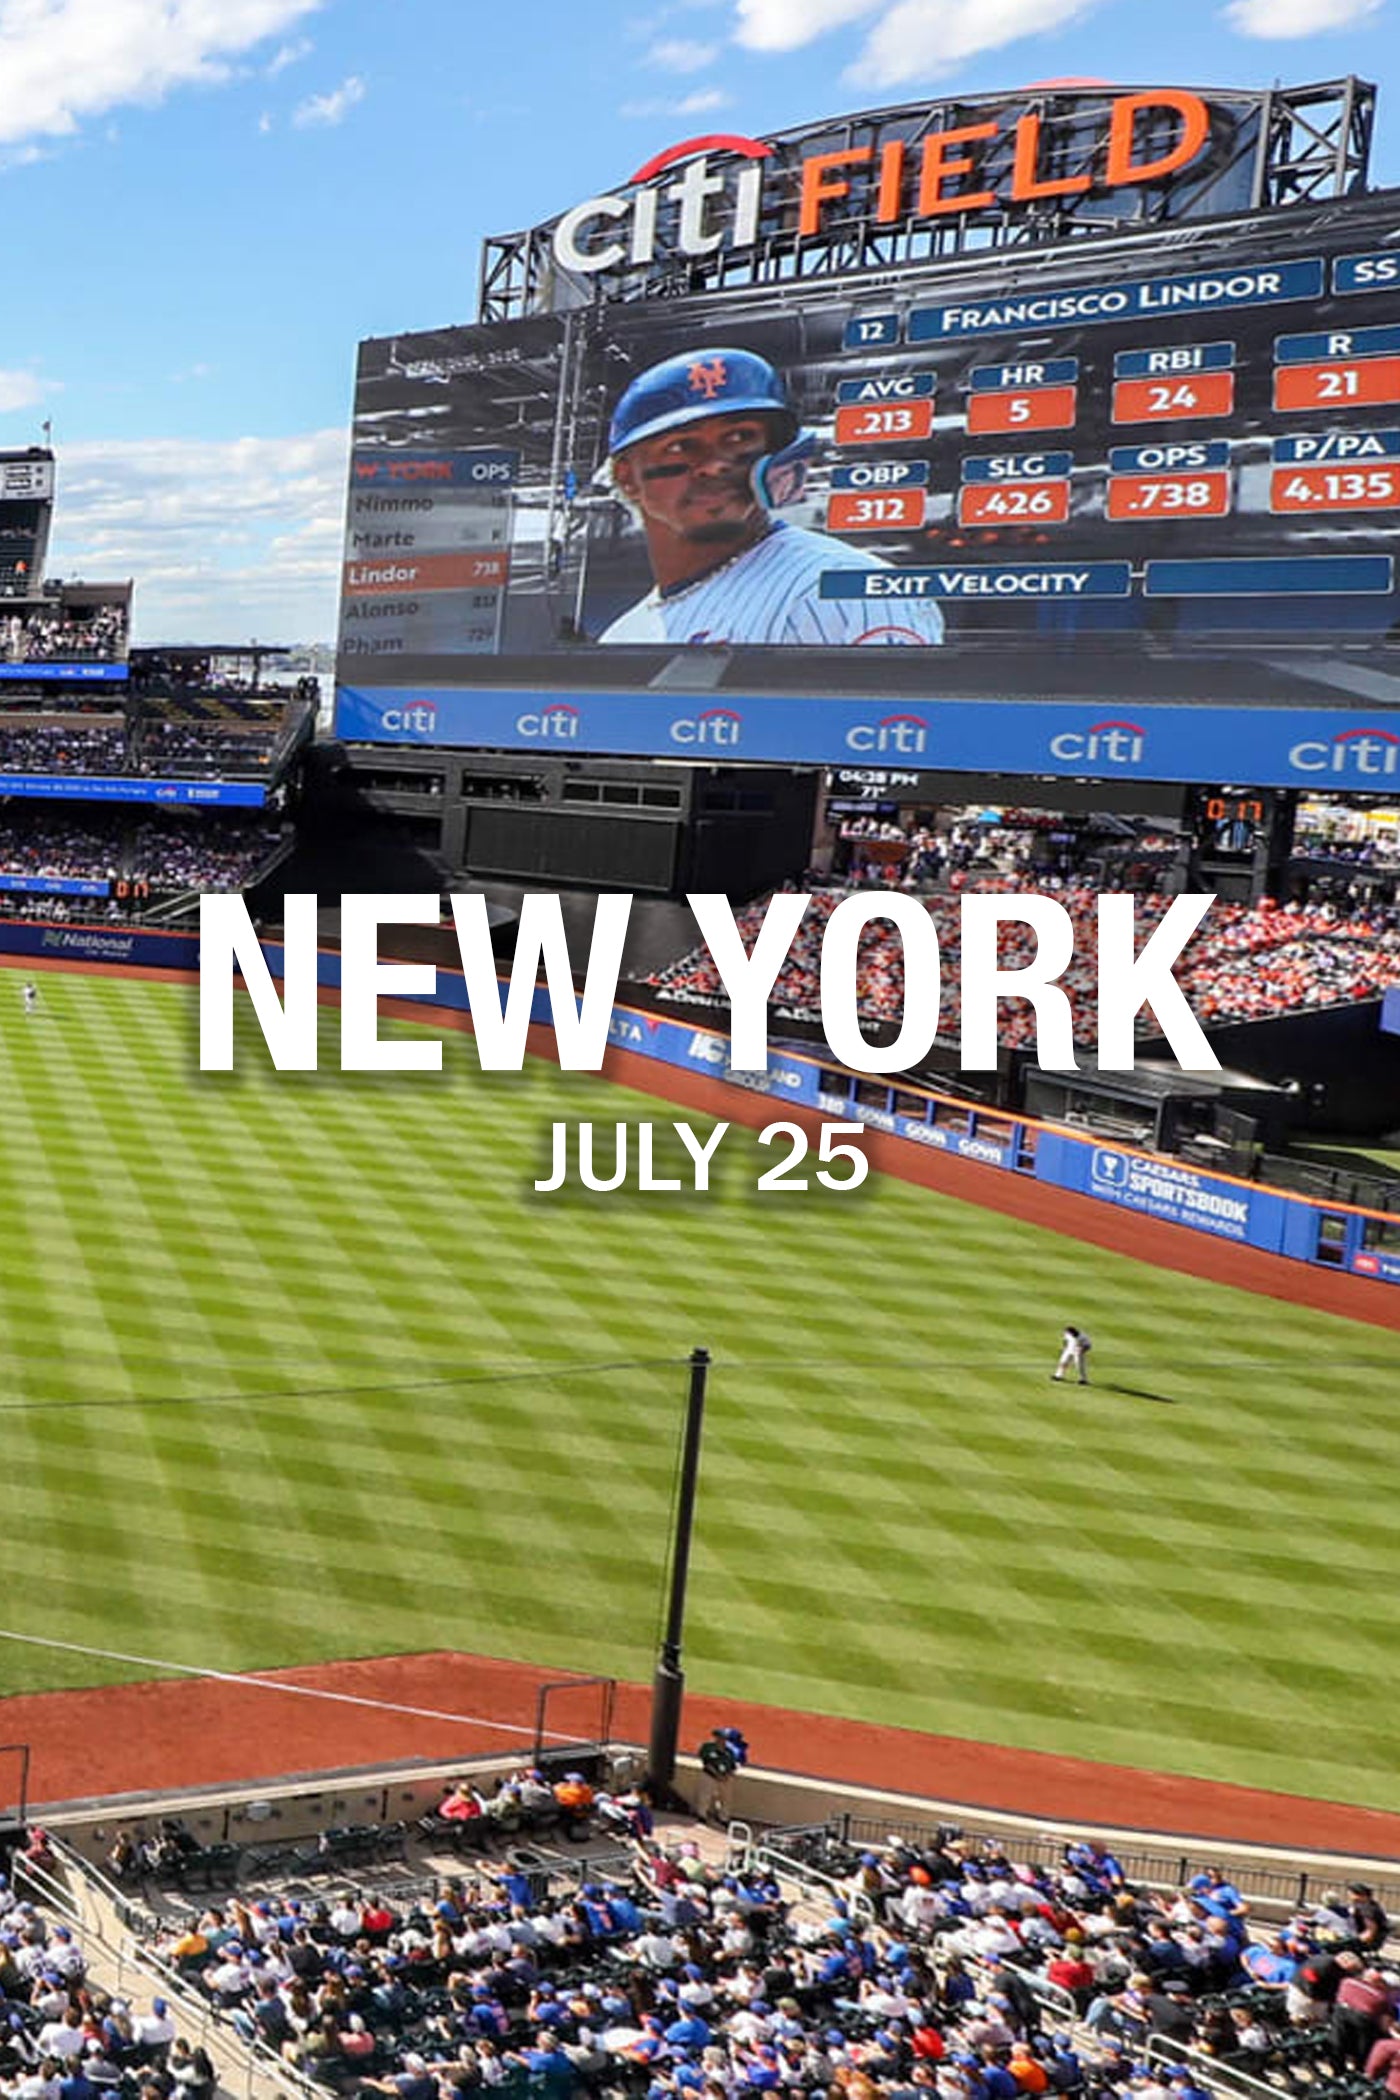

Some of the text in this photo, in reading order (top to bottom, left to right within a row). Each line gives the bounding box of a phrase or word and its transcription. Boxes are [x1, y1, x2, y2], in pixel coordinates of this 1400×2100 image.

[798, 89, 1209, 236] FIELD
[1353, 260, 1397, 282] SS
[942, 272, 1282, 332] FRANCISCO LINDOR
[858, 322, 886, 341] 12
[1328, 336, 1352, 354] R
[1149, 350, 1203, 372] RBI
[1000, 364, 1046, 387] HR
[1317, 371, 1359, 398] 21
[858, 377, 916, 398] AVG
[1147, 385, 1198, 413] 24
[854, 410, 912, 434] .213
[1009, 401, 1031, 423] 5
[1137, 446, 1207, 468] OPS
[1295, 436, 1386, 460] P/PA
[472, 463, 513, 481] OPS
[850, 465, 910, 486] OBP
[988, 457, 1046, 478] SLG
[1128, 483, 1211, 509] .738
[1285, 474, 1394, 502] 4.135
[355, 493, 435, 514] Nimmo
[846, 499, 904, 522] .312
[975, 490, 1053, 516] .426
[353, 529, 416, 547] Marte
[348, 565, 418, 586] Lindor
[345, 600, 420, 620] Alonso
[62, 932, 135, 950] National
[1131, 1158, 1201, 1188] CAESARS
[1129, 1171, 1249, 1224] SPORTSBOOK
